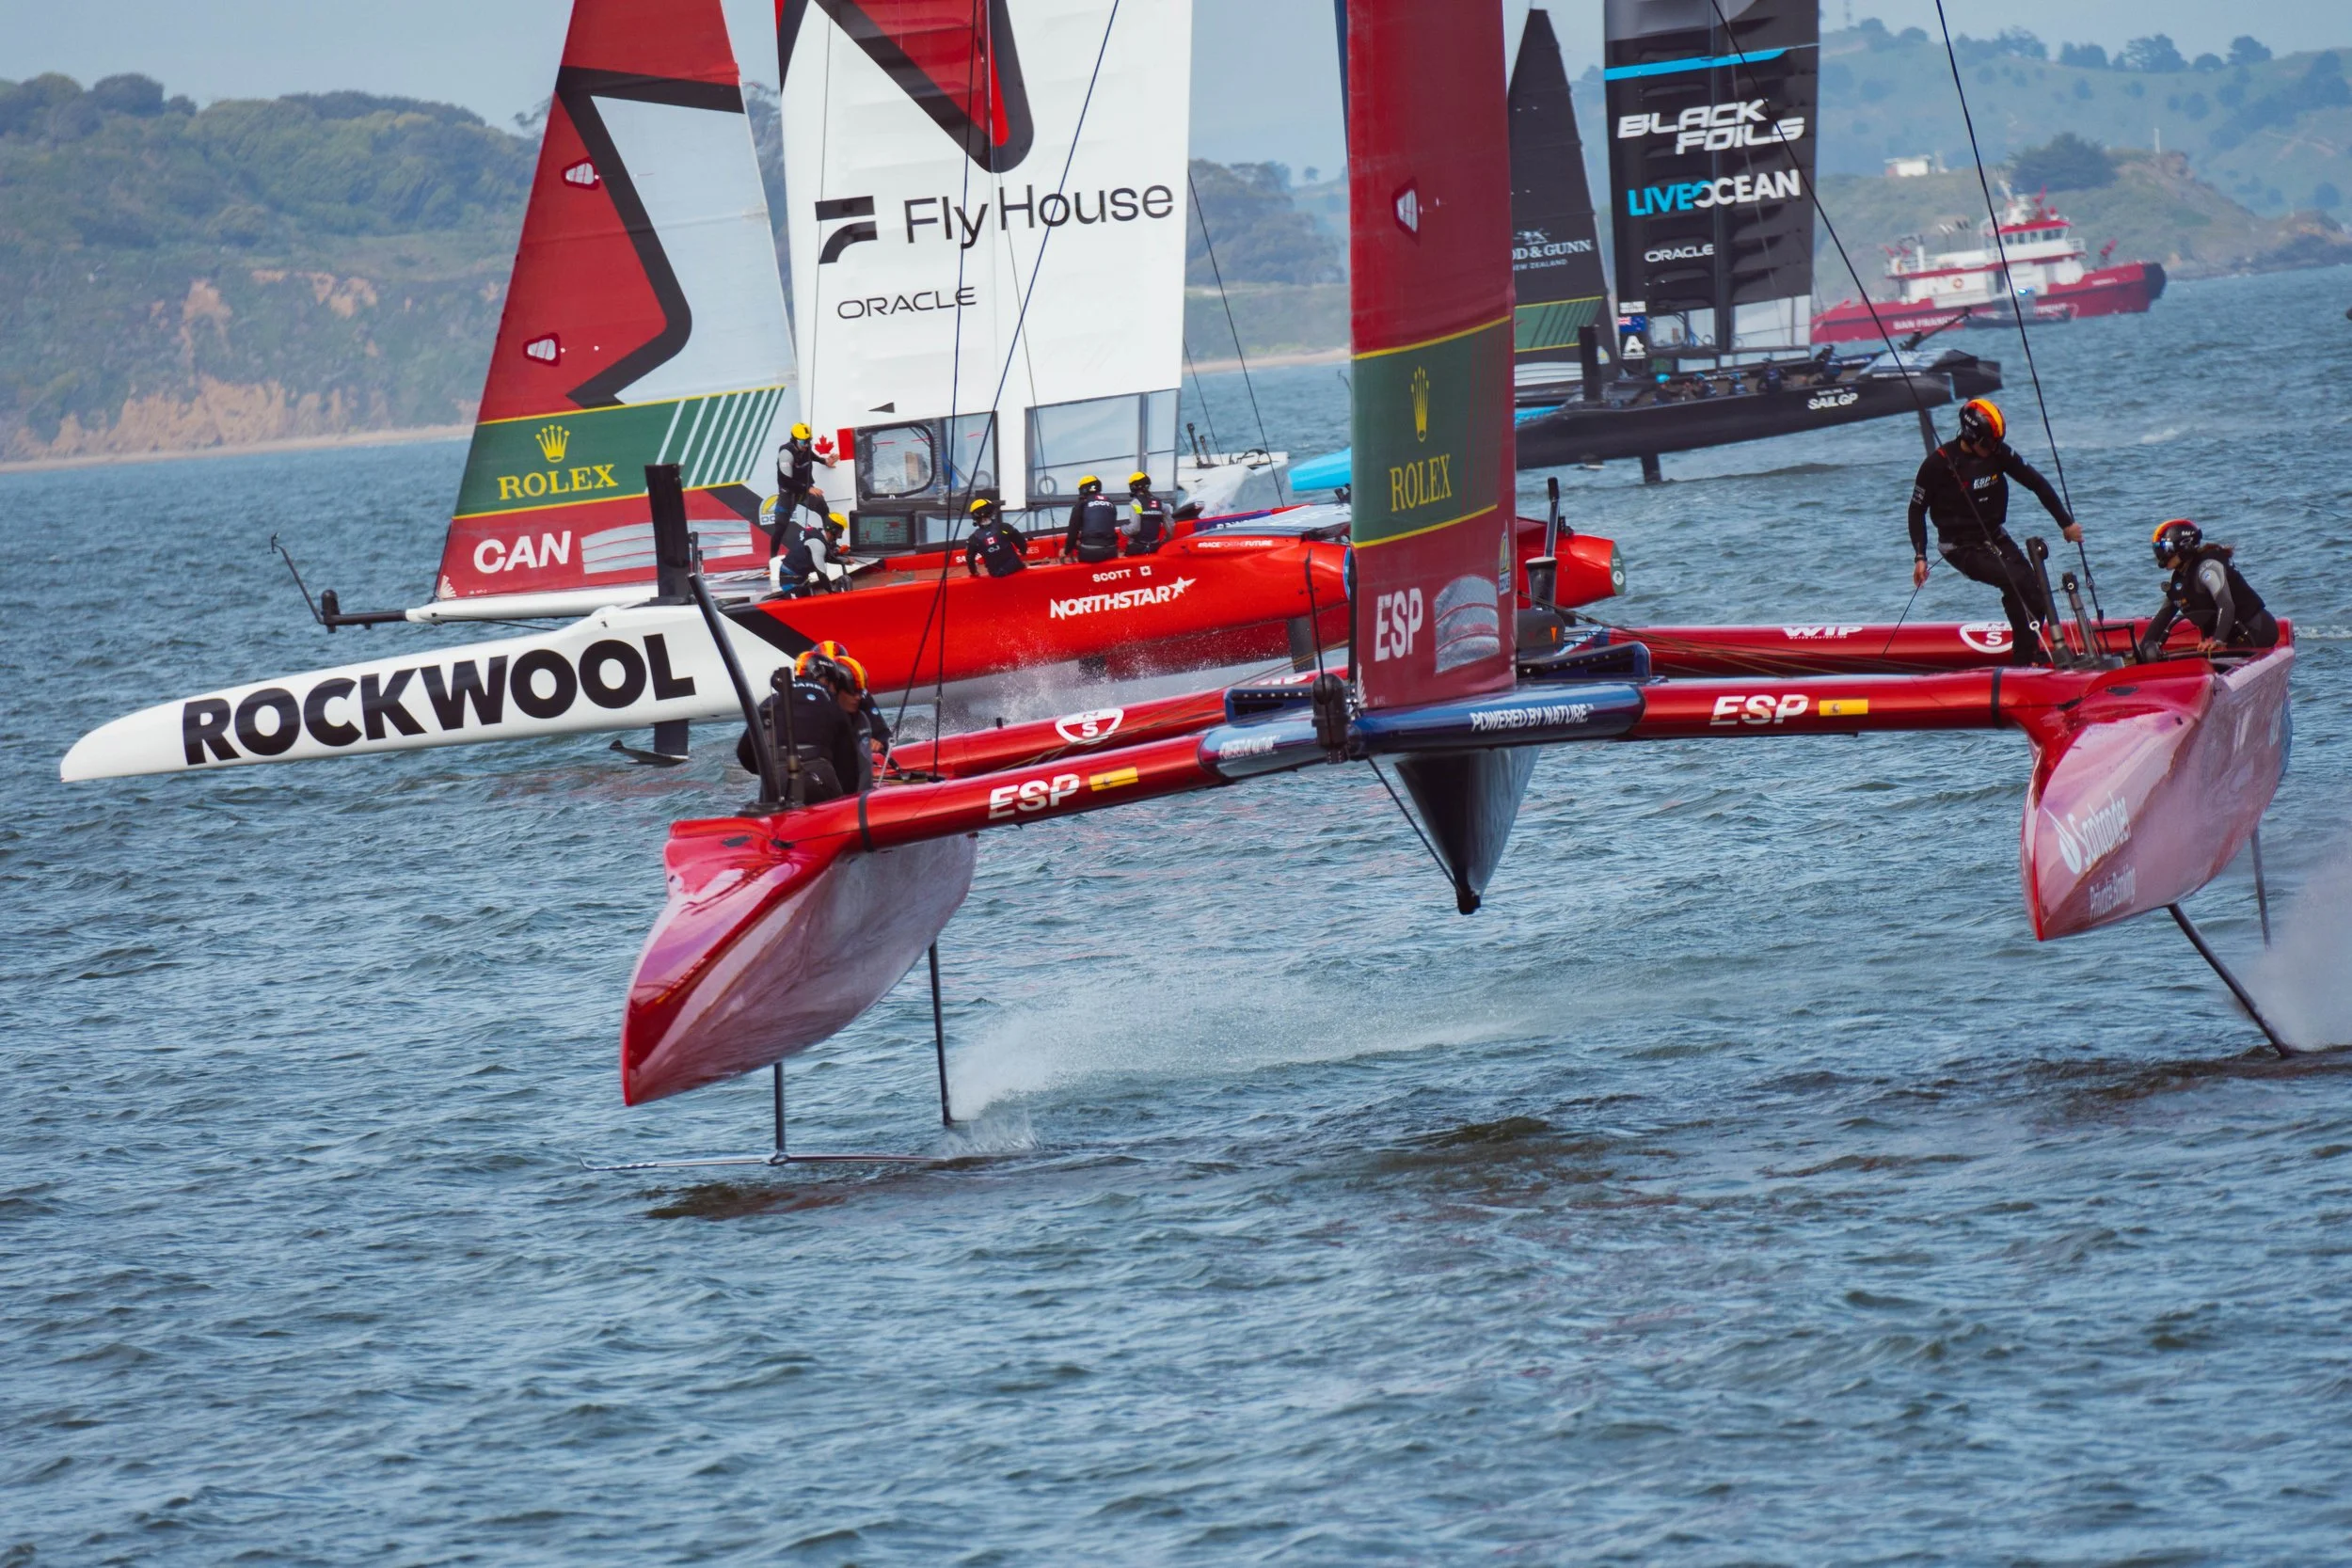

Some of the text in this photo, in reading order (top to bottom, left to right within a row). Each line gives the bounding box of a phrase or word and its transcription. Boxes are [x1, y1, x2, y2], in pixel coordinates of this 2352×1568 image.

[1618, 99, 1769, 138] BLACK
[1676, 117, 1805, 154] FOILS
[904, 184, 1174, 249] Fly House
[1544, 239, 1593, 256] GUNN
[1645, 244, 1715, 262] ORACLE
[837, 286, 977, 320] ORACLE
[497, 463, 618, 500] ROLEX
[1390, 453, 1453, 512] ROLEX
[473, 531, 571, 575] CAN
[1198, 540, 1273, 548] #RACEFORTHEFUTURE
[1092, 569, 1132, 582] SCOTT
[1050, 585, 1171, 620] NORTHSTAR
[1375, 587, 1423, 662] ESP
[1782, 626, 1864, 637] WIP
[182, 633, 697, 766] ROCKWOOL
[1709, 694, 1810, 727] ESP
[1470, 708, 1528, 732] POWERED
[1526, 706, 1544, 726] BY
[989, 773, 1080, 819] ESP
